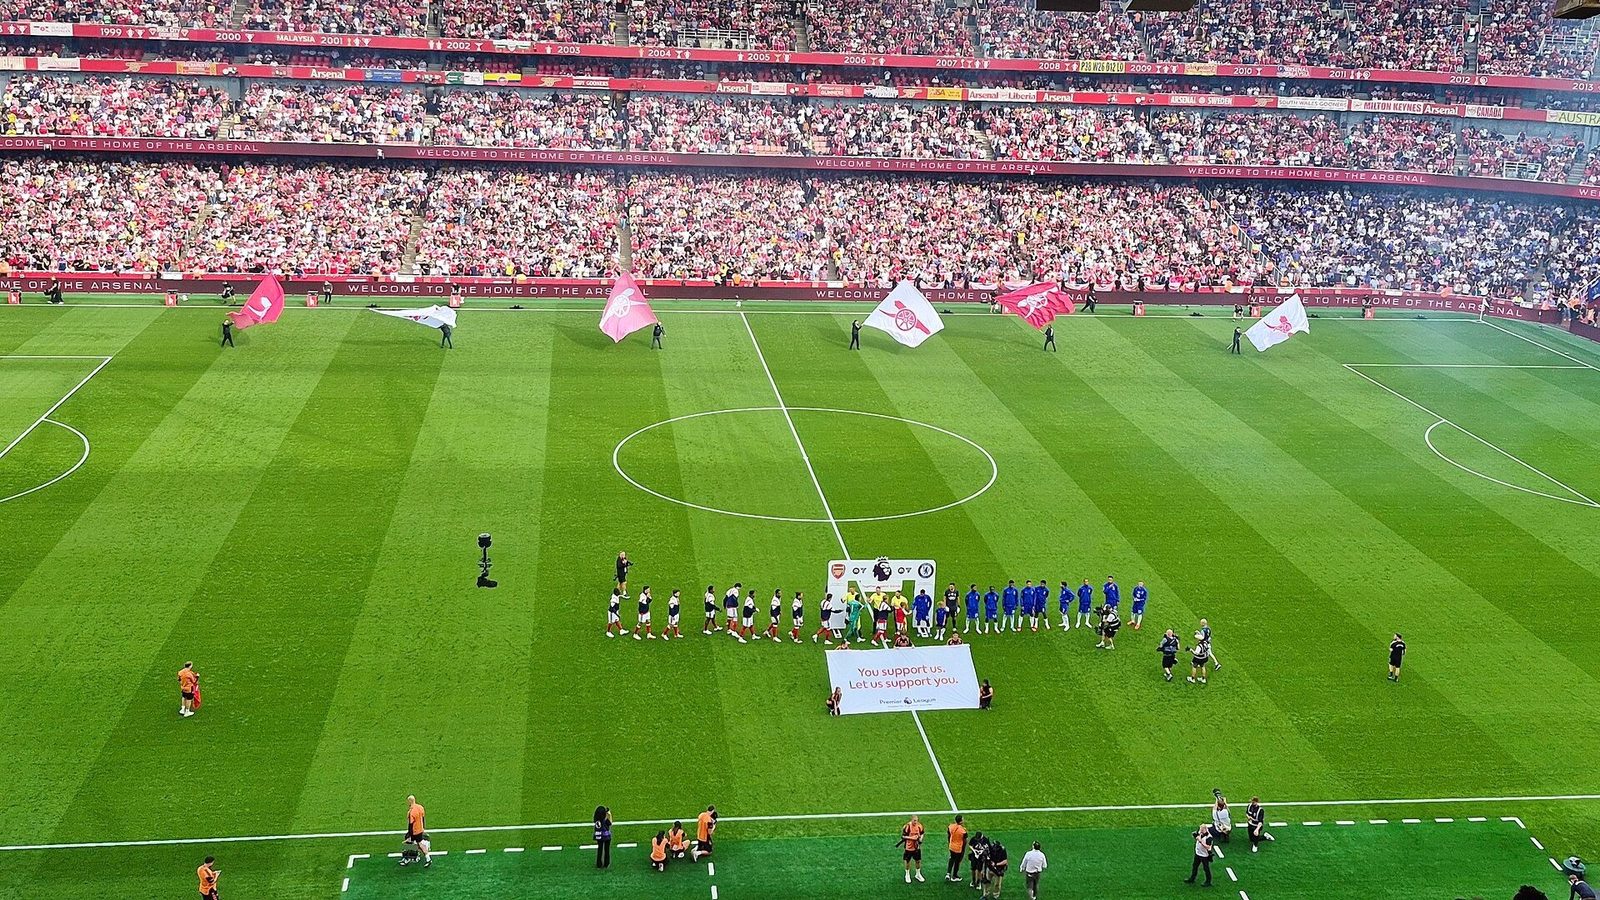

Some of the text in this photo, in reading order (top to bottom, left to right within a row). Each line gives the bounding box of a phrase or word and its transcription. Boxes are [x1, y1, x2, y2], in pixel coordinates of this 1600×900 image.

[100, 28, 123, 37] 1999
[215, 33, 242, 42] 2000
[276, 35, 316, 43] MALAYSIA
[320, 36, 344, 46] 2001
[447, 41, 471, 50] 2002
[557, 46, 581, 55] 2003
[648, 49, 672, 58] 2004
[747, 53, 771, 62] 2005
[844, 56, 867, 65] 2006
[936, 59, 958, 68] 2007
[1038, 62, 1061, 70] 2008
[1131, 64, 1152, 73] 2009
[1233, 67, 1253, 75] 2010
[310, 68, 346, 79] Arsenal
[1329, 70, 1347, 78] 2011
[1450, 76, 1470, 84] 2012
[716, 83, 749, 92] Arsenal
[1573, 82, 1594, 91] 2013
[969, 90, 999, 99] Arsenal
[1007, 92, 1036, 100] Liberia
[1042, 94, 1073, 102] Arsenal
[1170, 96, 1198, 104] ARSENAL
[1363, 102, 1422, 112] MILTON KEYNES
[1424, 105, 1458, 114] Arsenal
[1477, 107, 1502, 117] CANADA
[50, 139, 67, 147] TO
[72, 140, 97, 149] THE
[103, 141, 140, 149] HOME
[146, 142, 162, 150] OF
[168, 142, 192, 150] THE
[199, 143, 259, 152] ARSENAL
[417, 149, 477, 158] WELCOME
[483, 151, 498, 159] TO
[503, 151, 526, 159] THE
[590, 154, 613, 162] THE
[617, 155, 672, 163] ARSENAL
[816, 159, 871, 168] WELCOME
[895, 161, 916, 169] THE
[921, 162, 952, 170] HOME
[957, 163, 971, 171] OF
[1001, 164, 1052, 172] ARSENAL
[1188, 167, 1241, 176] WELCOME
[1288, 170, 1320, 178] HOME
[1344, 172, 1366, 180] THE
[1371, 174, 1426, 183] ARSENAL
[29, 281, 47, 289] OF
[91, 281, 162, 291] ARSENAL
[348, 285, 420, 294] WELCOME
[427, 286, 444, 294] TO
[484, 287, 523, 295] HOME
[530, 287, 547, 295] OF
[554, 287, 580, 295] THE
[586, 288, 649, 296] ARSL
[816, 290, 881, 299] WELCOME
[938, 292, 974, 300] HOME
[1315, 297, 1330, 305] TO
[1335, 297, 1360, 305] THE
[1366, 297, 1400, 306] OME
[1405, 299, 1422, 307] OF
[1428, 300, 1453, 309] THE
[858, 665, 946, 678] You support us.
[849, 677, 958, 690] Let us support you.
[912, 697, 937, 705] League
